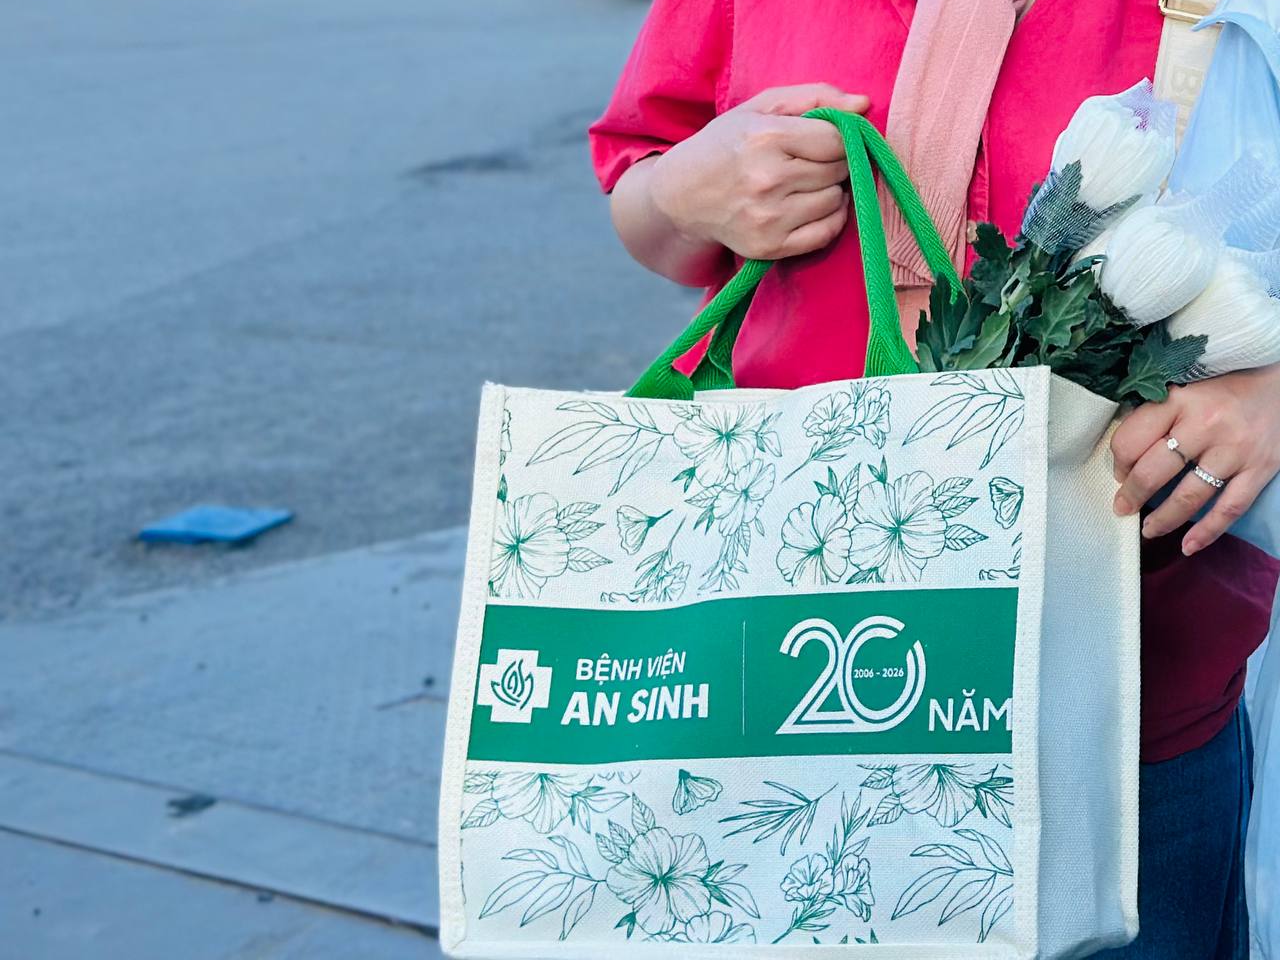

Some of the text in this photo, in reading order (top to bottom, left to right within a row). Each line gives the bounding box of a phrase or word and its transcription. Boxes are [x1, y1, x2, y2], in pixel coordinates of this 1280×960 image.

[575, 647, 687, 686] BỆNH VIỆN
[775, 615, 1013, 735] 20 NĂM
[853, 668, 874, 679] 2006
[882, 667, 905, 678] 2026
[560, 683, 710, 726] AN SINH
